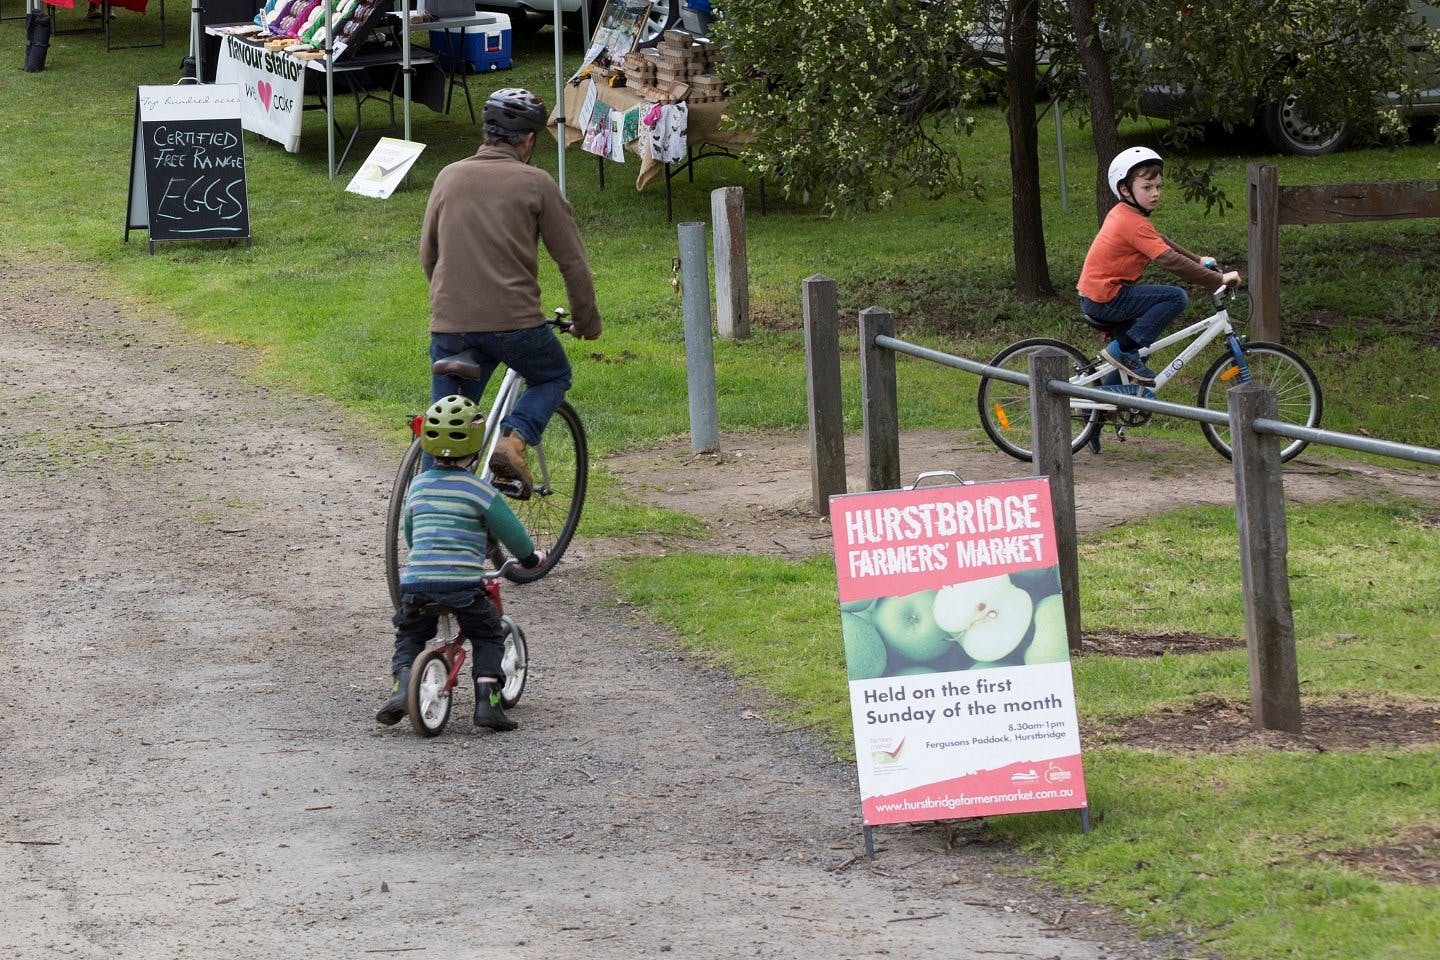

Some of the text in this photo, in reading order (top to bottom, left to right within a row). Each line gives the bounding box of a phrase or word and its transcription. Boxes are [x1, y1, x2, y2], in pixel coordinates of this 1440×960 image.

[227, 35, 262, 70] flavour
[157, 175, 242, 220] EGGS
[845, 493, 1040, 545] HURSTBRIDGE
[849, 533, 1044, 578] FARMERS' MARKET
[864, 678, 1012, 704] Held on the first
[866, 693, 1063, 725] Sunday of the month
[926, 738, 970, 750] Fergusons
[1015, 730, 1066, 742] Hurstbridge
[1008, 720, 1065, 732] 8.30am-1pm
[876, 788, 1074, 813] www.hurstbridgefarmersmarket.com.au
